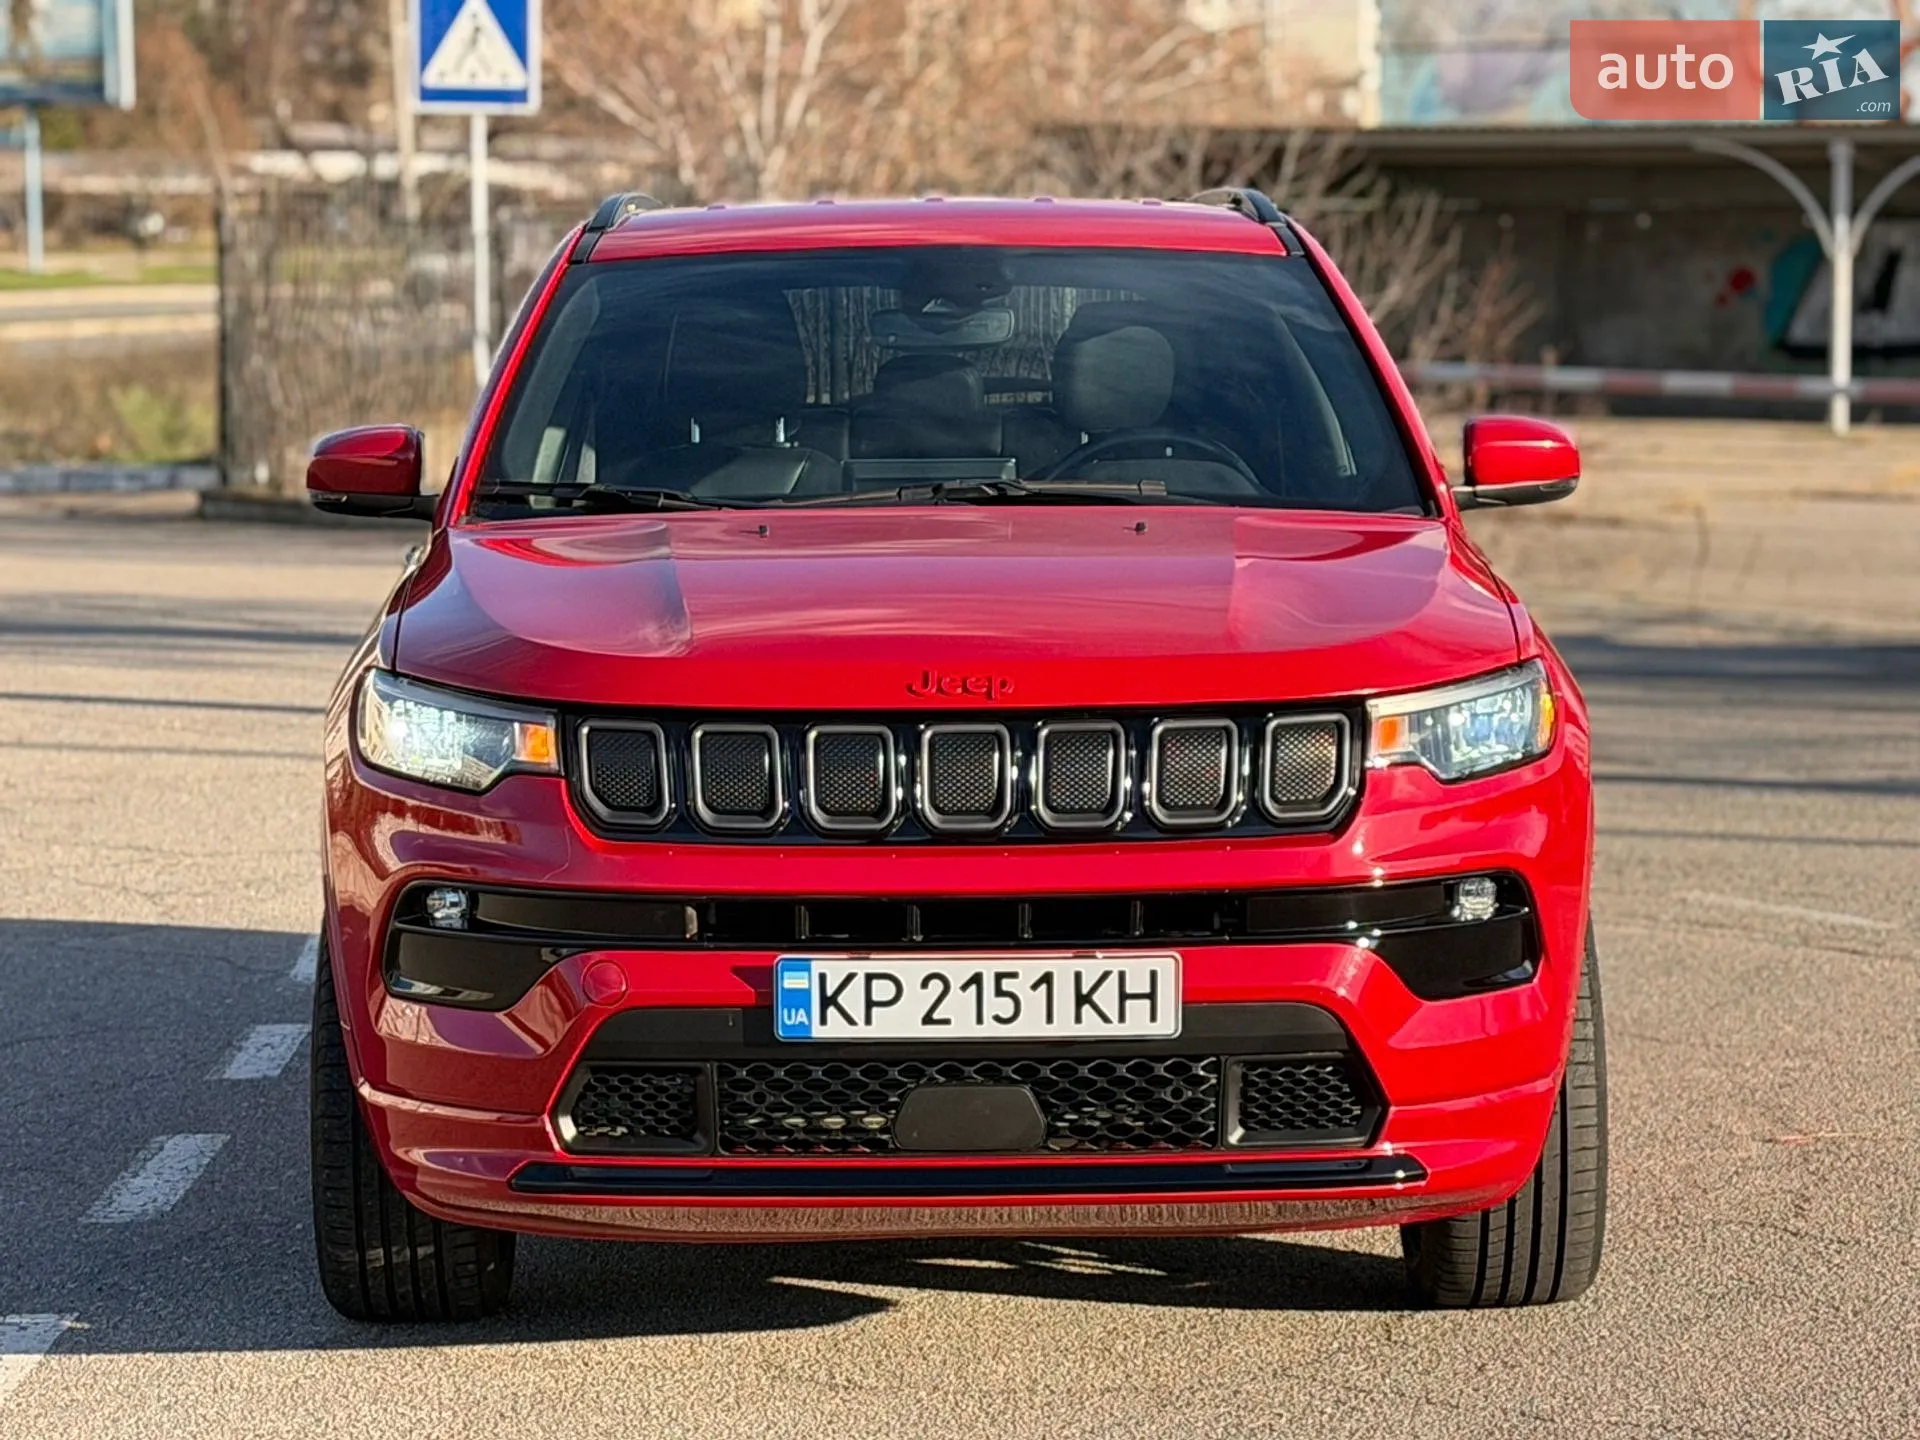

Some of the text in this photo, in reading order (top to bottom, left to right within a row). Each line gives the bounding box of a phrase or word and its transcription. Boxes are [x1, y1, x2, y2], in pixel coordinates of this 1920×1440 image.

[904, 669, 1015, 702] Jeep
[817, 968, 1159, 1027] KP 2151 KH
[783, 1007, 809, 1026] UA
